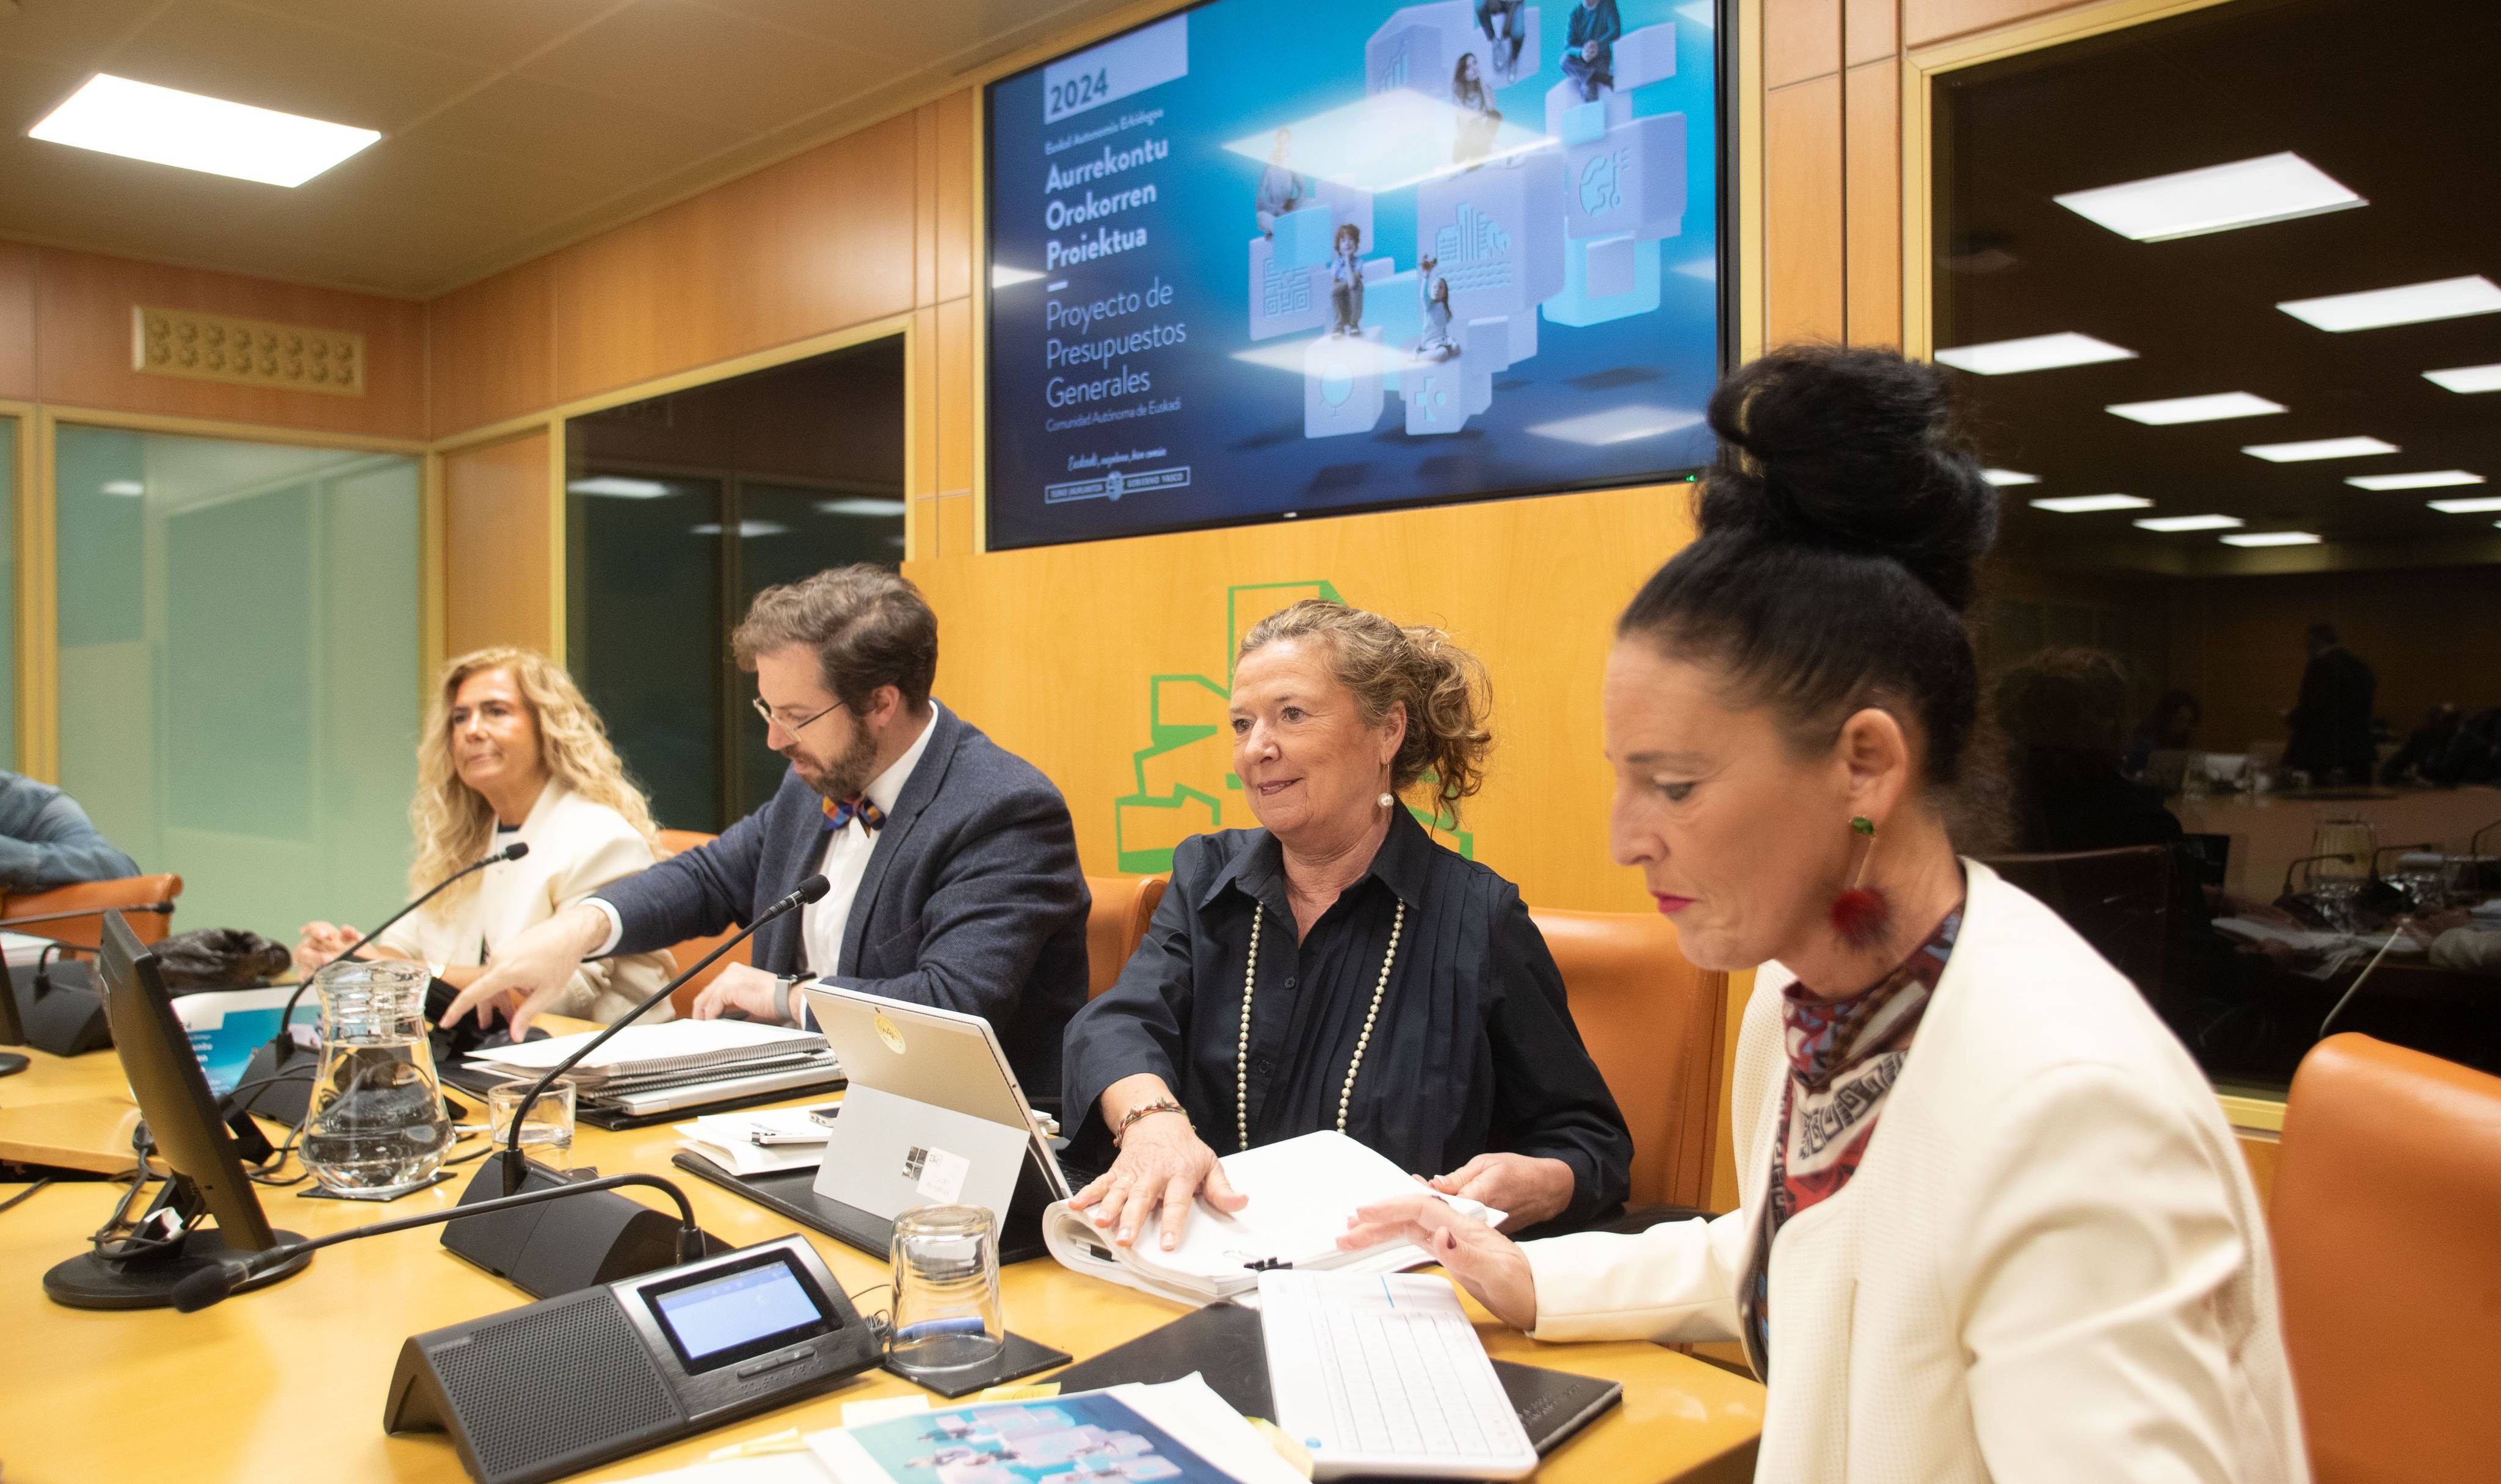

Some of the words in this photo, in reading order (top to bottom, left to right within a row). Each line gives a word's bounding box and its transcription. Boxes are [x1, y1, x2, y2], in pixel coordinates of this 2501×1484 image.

[1051, 68, 1107, 114] 2024
[1045, 138, 1168, 194] Aurrekontu
[1045, 184, 1156, 231] Orokorren
[1047, 225, 1147, 270] Proiektua
[1046, 291, 1141, 335] Proyecto
[1145, 277, 1174, 308] de
[1046, 322, 1187, 369] Presupuestos
[1046, 364, 1151, 408] Generales
